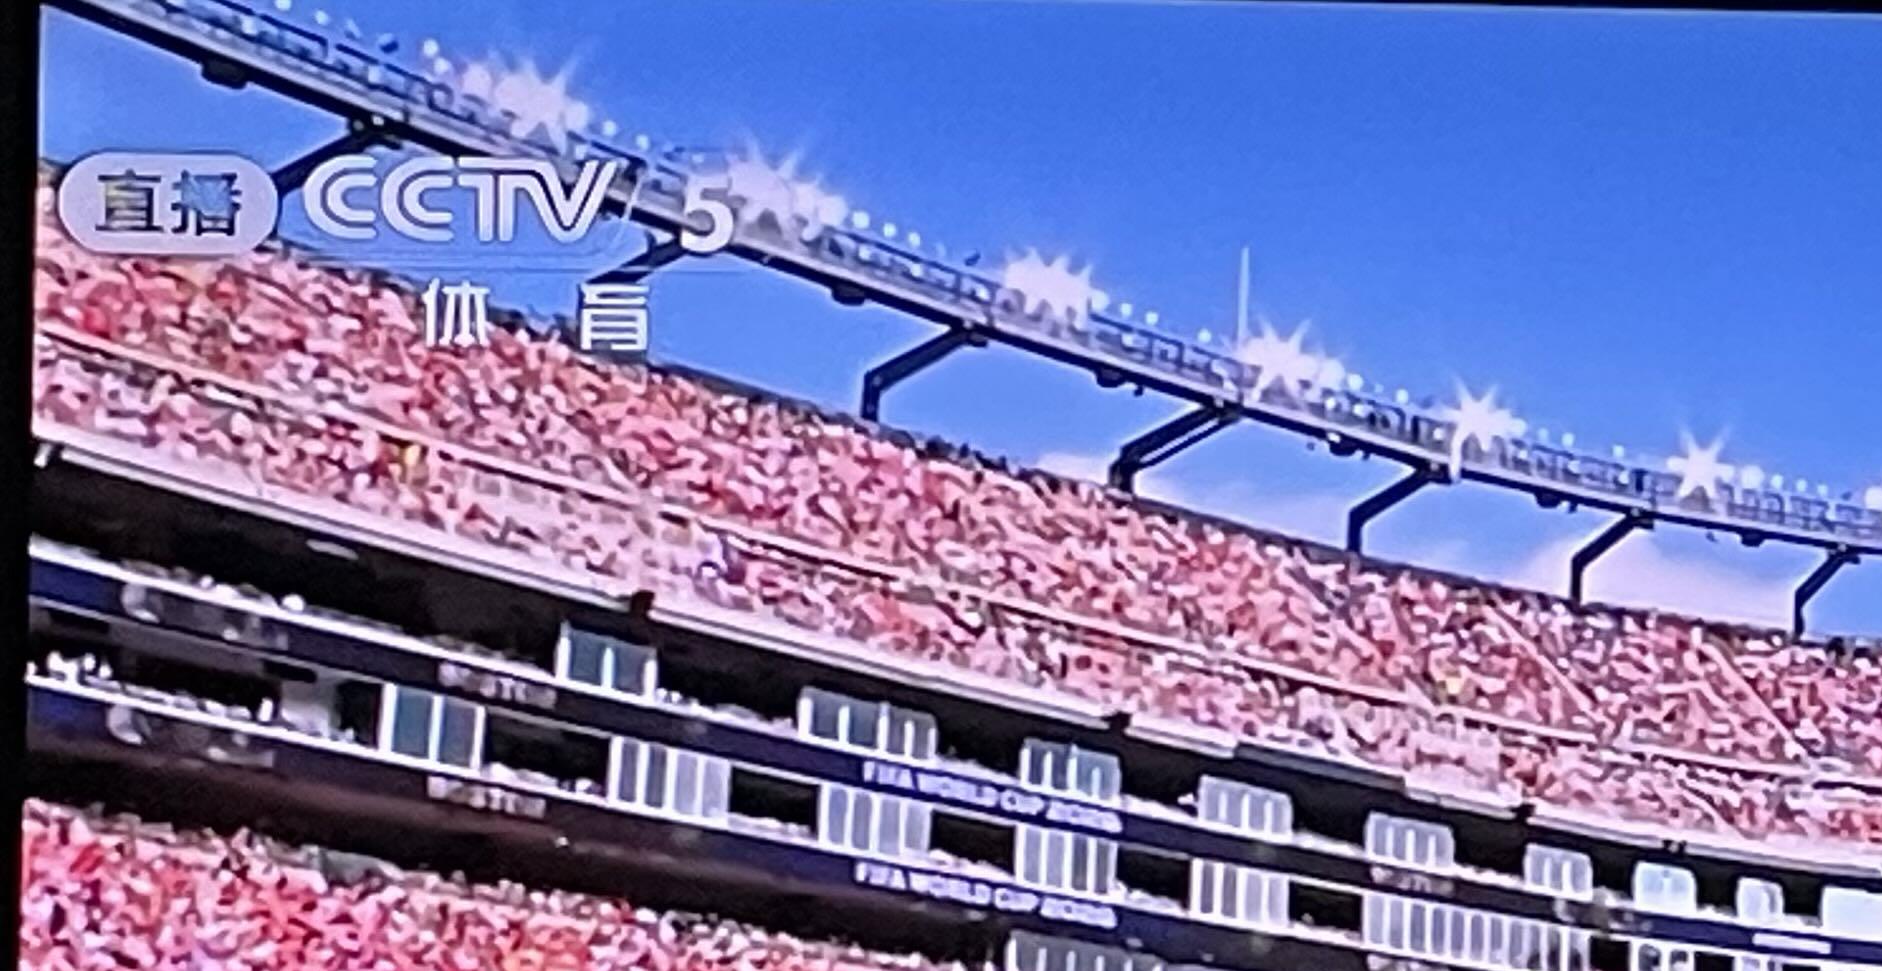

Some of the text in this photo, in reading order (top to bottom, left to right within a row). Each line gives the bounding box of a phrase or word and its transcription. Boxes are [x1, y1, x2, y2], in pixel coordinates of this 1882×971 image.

[96, 169, 242, 236] 直播
[303, 155, 735, 253] CCTV 5
[422, 277, 650, 351] 体育
